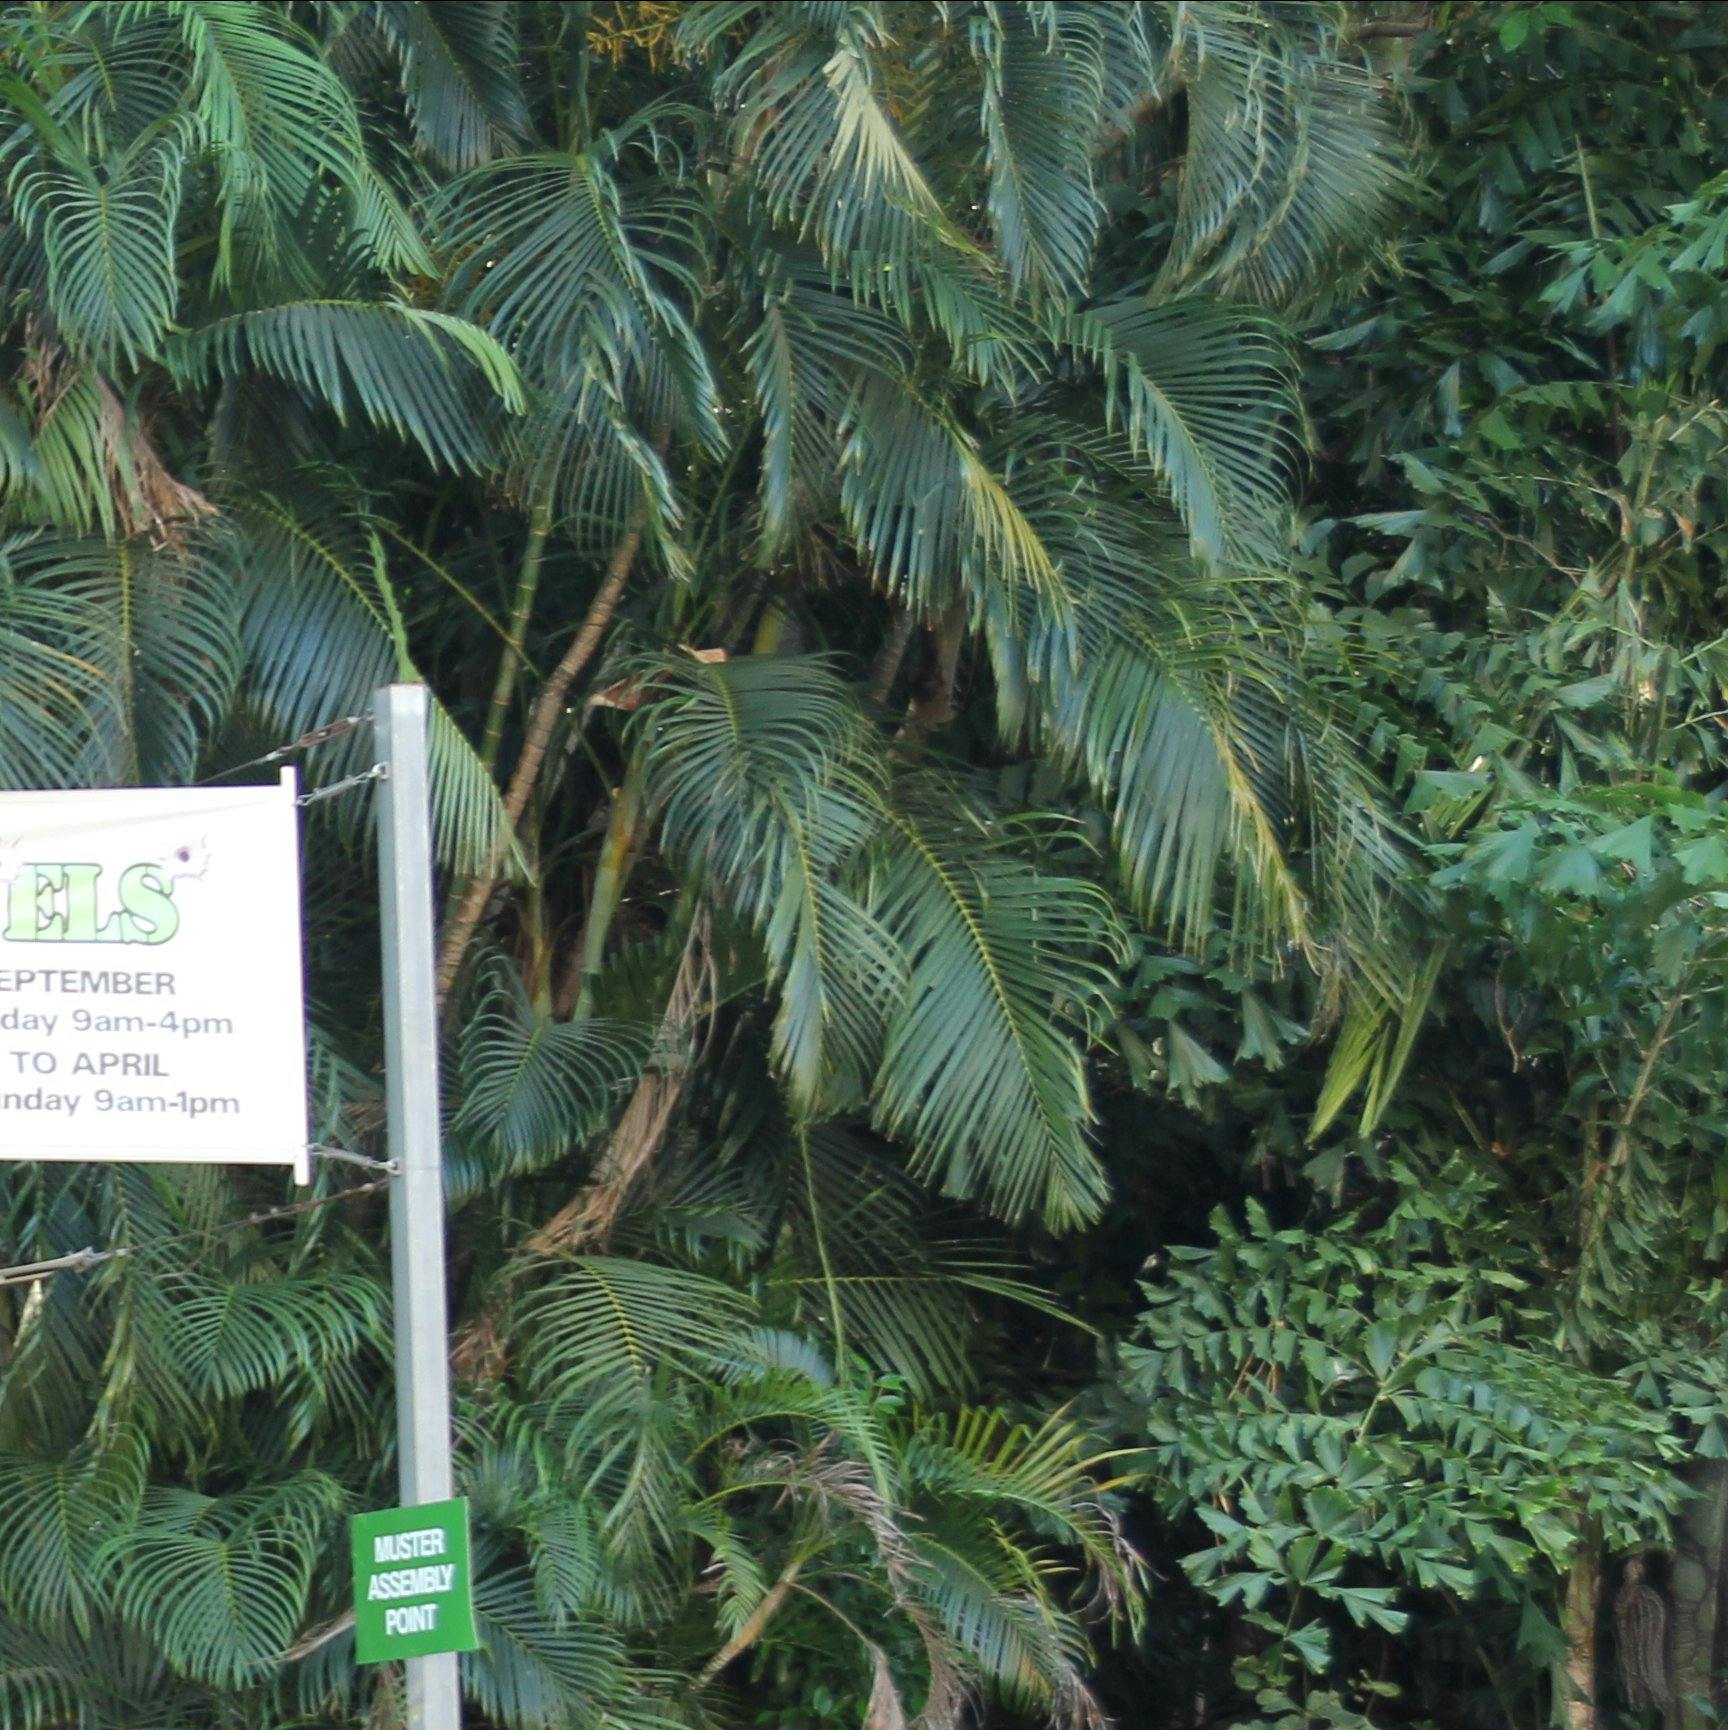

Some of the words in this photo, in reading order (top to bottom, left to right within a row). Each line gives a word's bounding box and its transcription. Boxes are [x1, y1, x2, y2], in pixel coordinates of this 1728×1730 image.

[72, 1011, 233, 1038] 9am-4pm
[10, 1051, 57, 1074] TO
[71, 1053, 170, 1077] APRIL
[95, 1090, 240, 1118] 9am-1pm
[374, 1528, 445, 1563] MUSTER
[368, 1564, 455, 1600] ASSEMBLY
[385, 1604, 438, 1635] POINT
